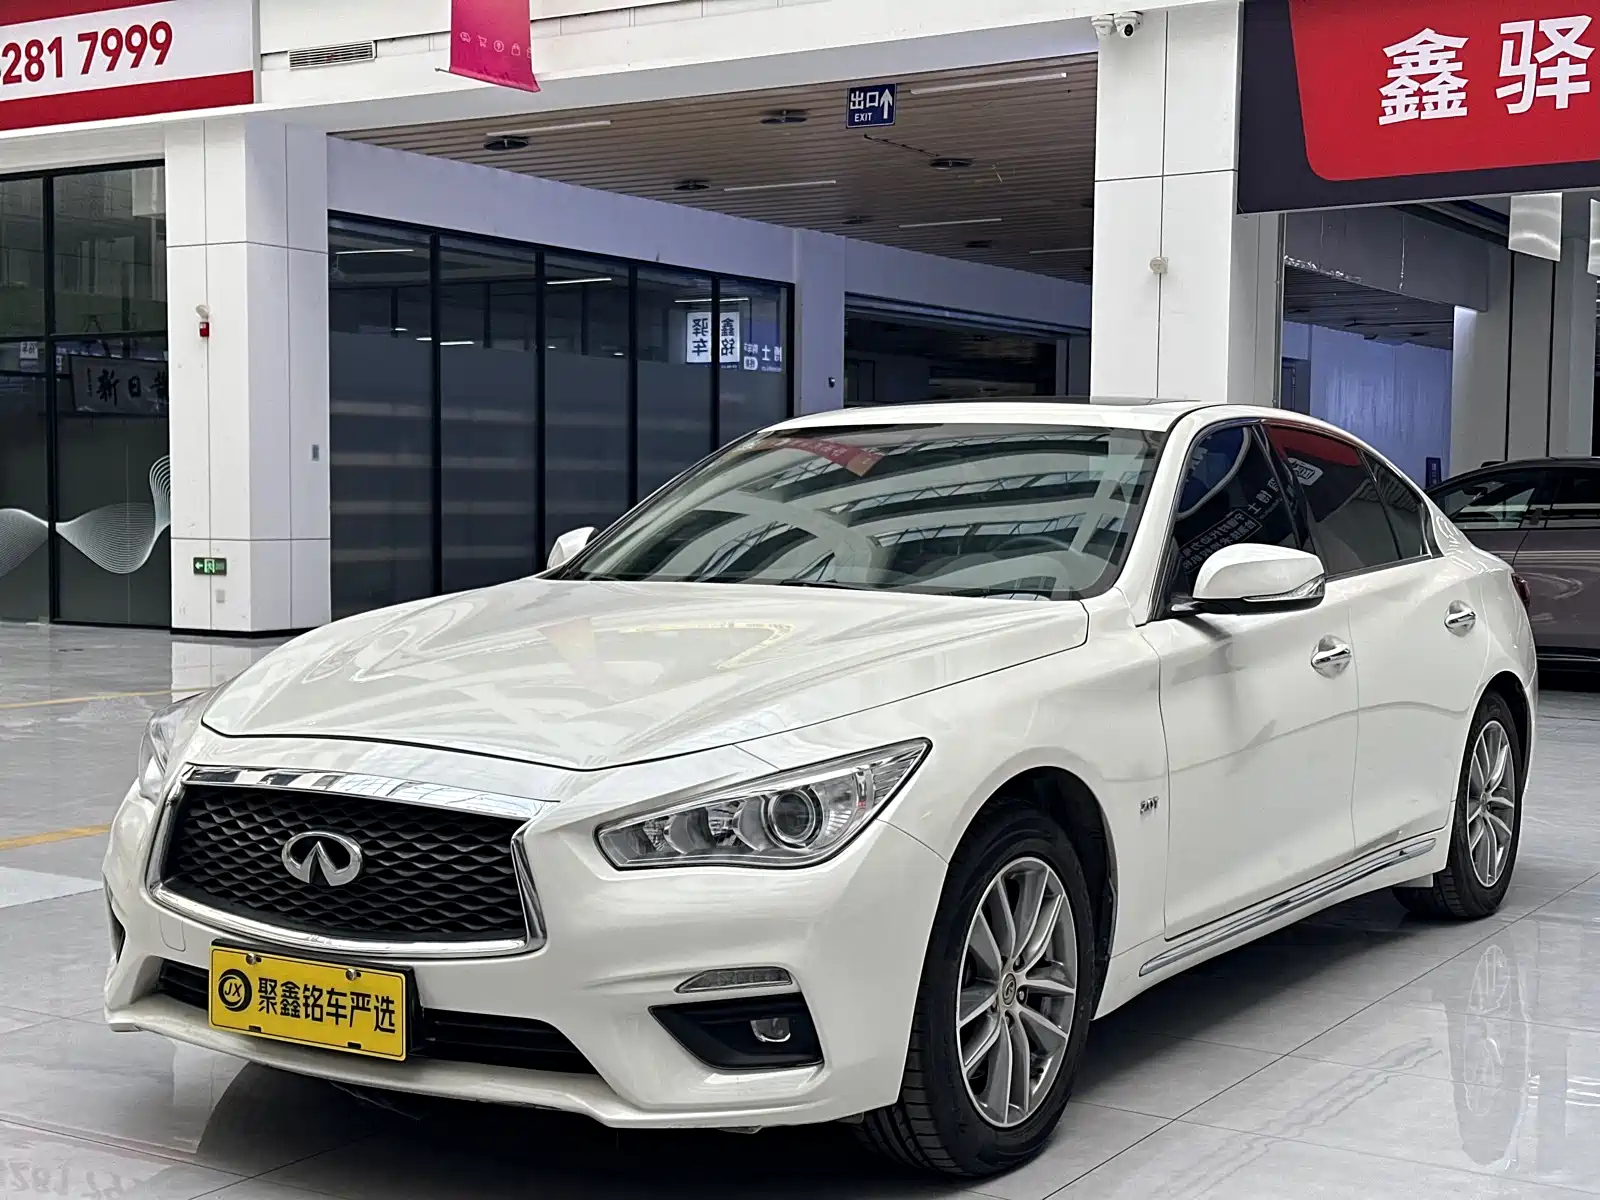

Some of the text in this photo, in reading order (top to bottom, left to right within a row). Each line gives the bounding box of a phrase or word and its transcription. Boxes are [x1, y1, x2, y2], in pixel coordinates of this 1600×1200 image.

[77, 20, 173, 75] 7999
[1378, 15, 1596, 126] 鑫驿
[850, 91, 879, 110] 出口
[854, 113, 872, 122] EXIT
[224, 982, 243, 998] JX
[258, 977, 396, 1034] 聚鑫铭车严选
